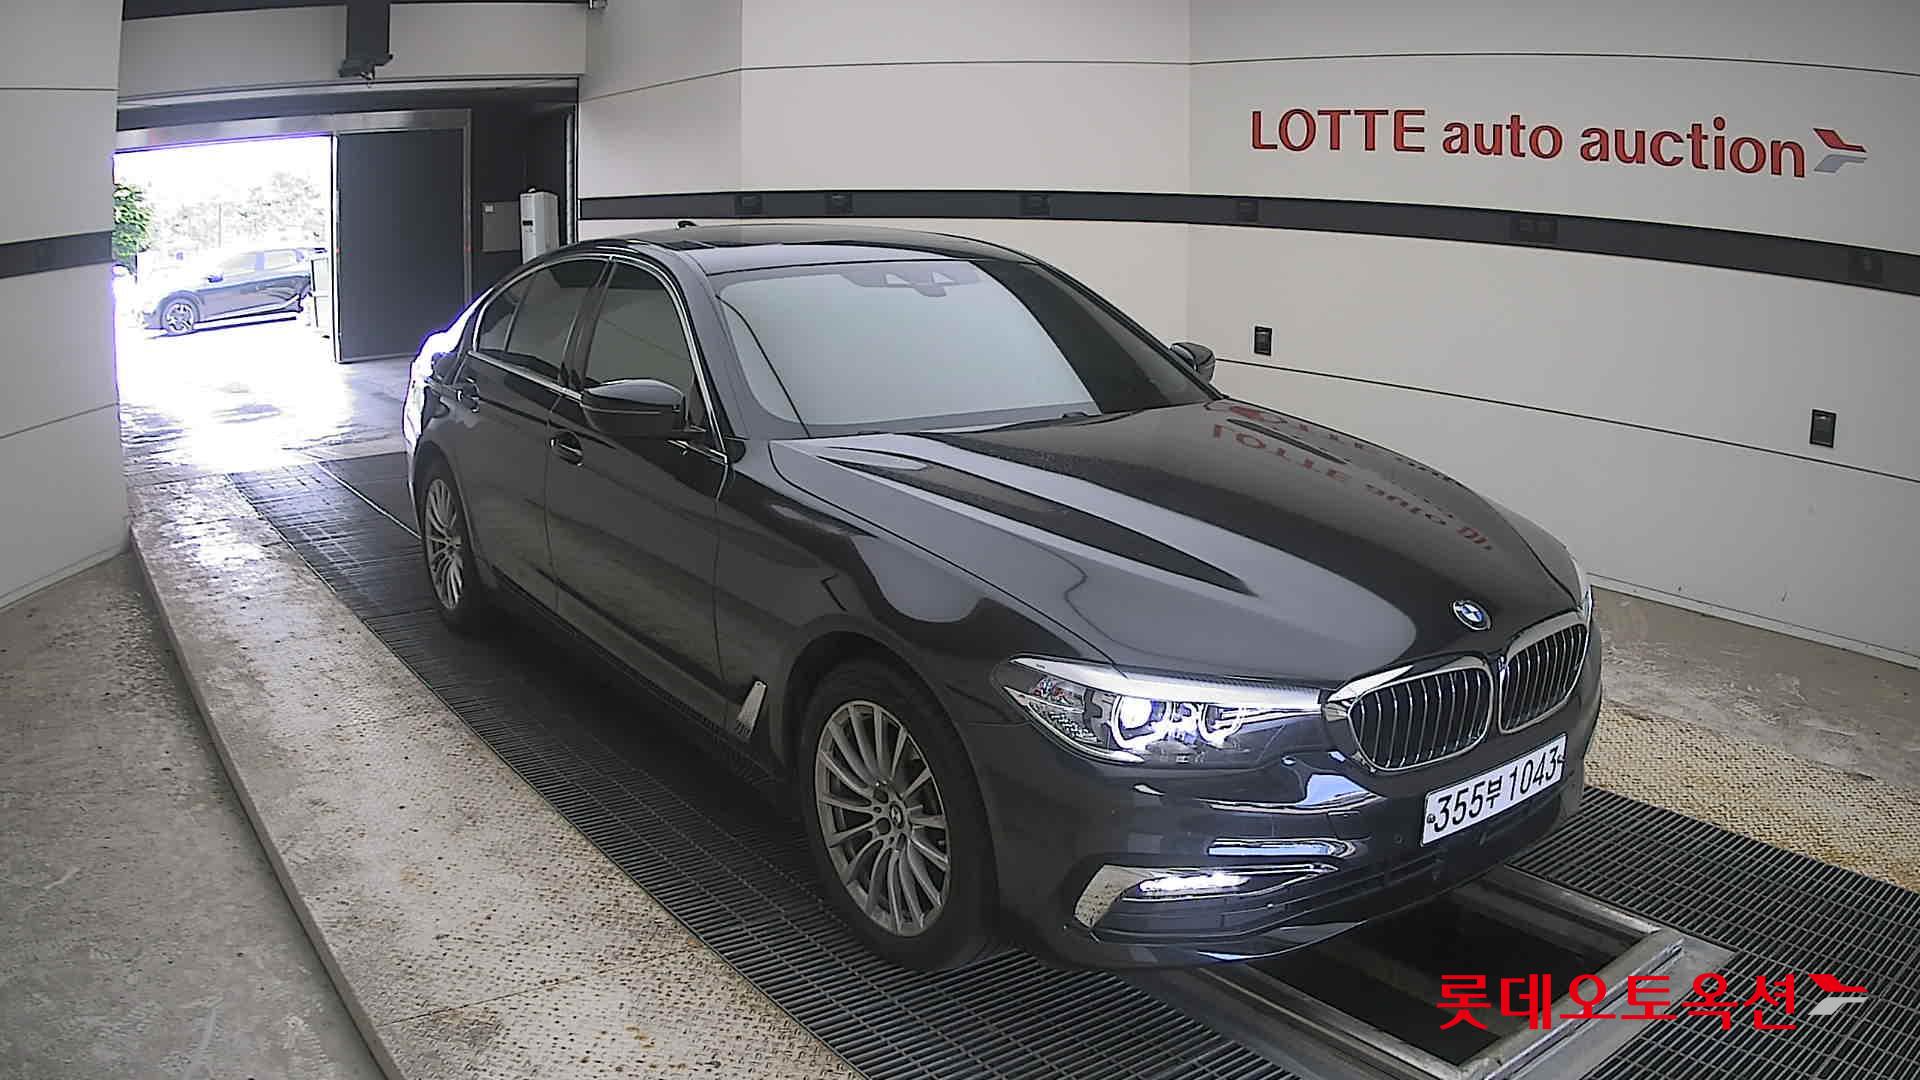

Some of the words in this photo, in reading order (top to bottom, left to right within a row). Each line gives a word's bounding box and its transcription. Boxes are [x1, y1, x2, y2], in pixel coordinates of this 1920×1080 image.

[1252, 108, 1426, 153] LOTTE
[1442, 114, 1563, 159] auto
[1580, 117, 1806, 178] auction
[1433, 775, 1503, 833] 355부
[1509, 745, 1560, 801] 1043
